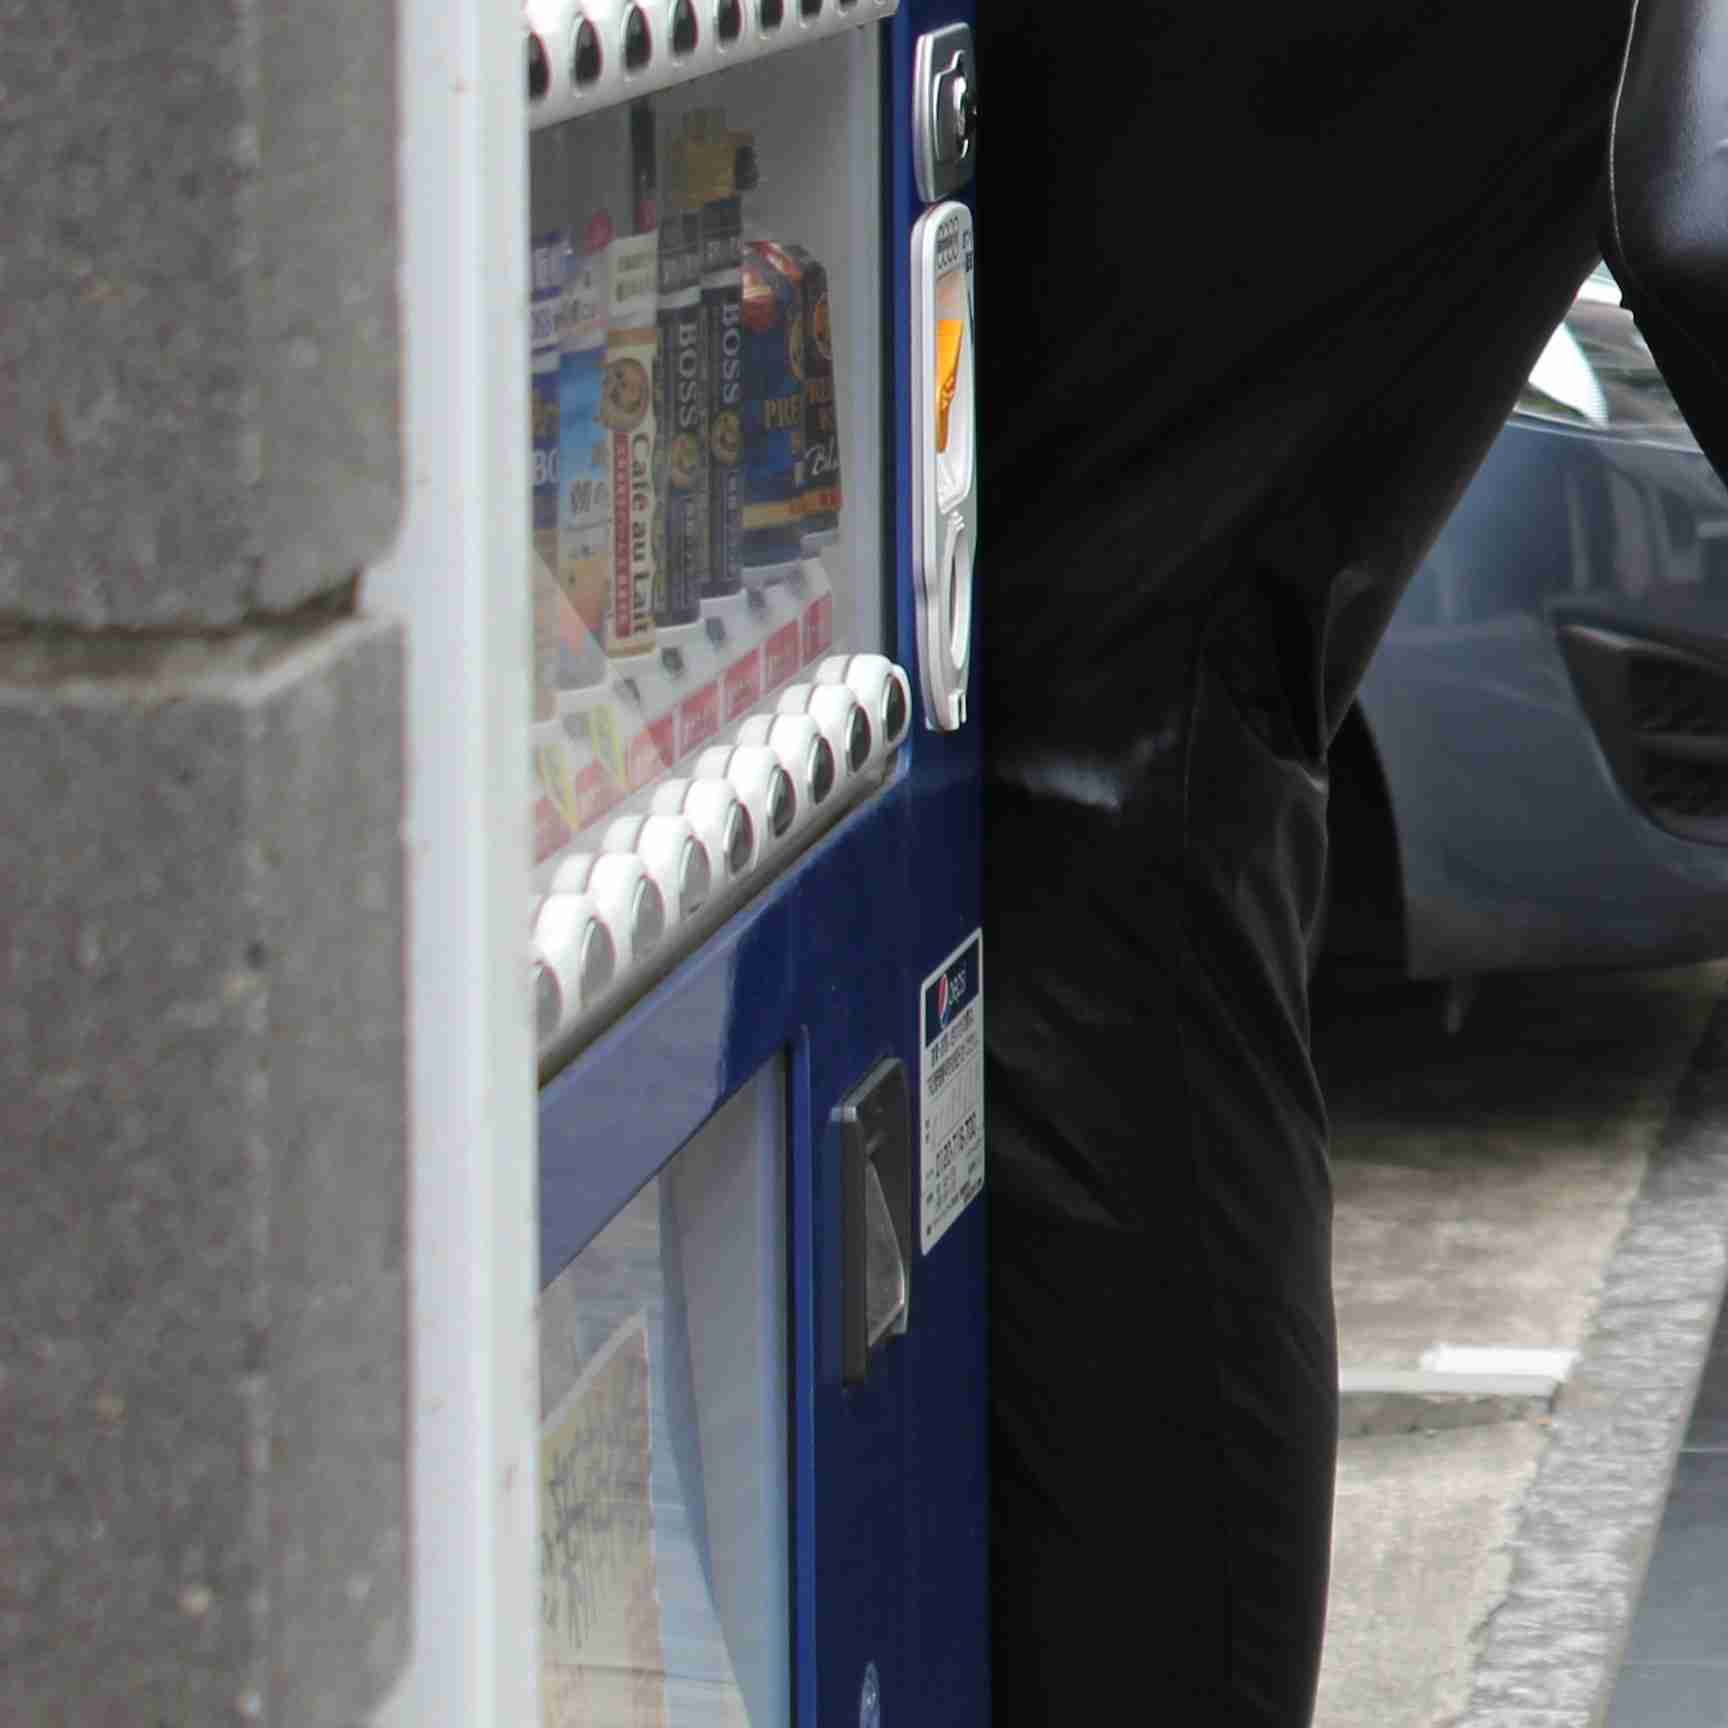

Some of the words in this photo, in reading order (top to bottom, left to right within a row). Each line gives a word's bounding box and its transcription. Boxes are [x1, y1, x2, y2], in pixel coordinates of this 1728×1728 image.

[678, 323, 699, 429] BOSS
[721, 303, 741, 405] BOSS
[632, 521, 648, 563] au
